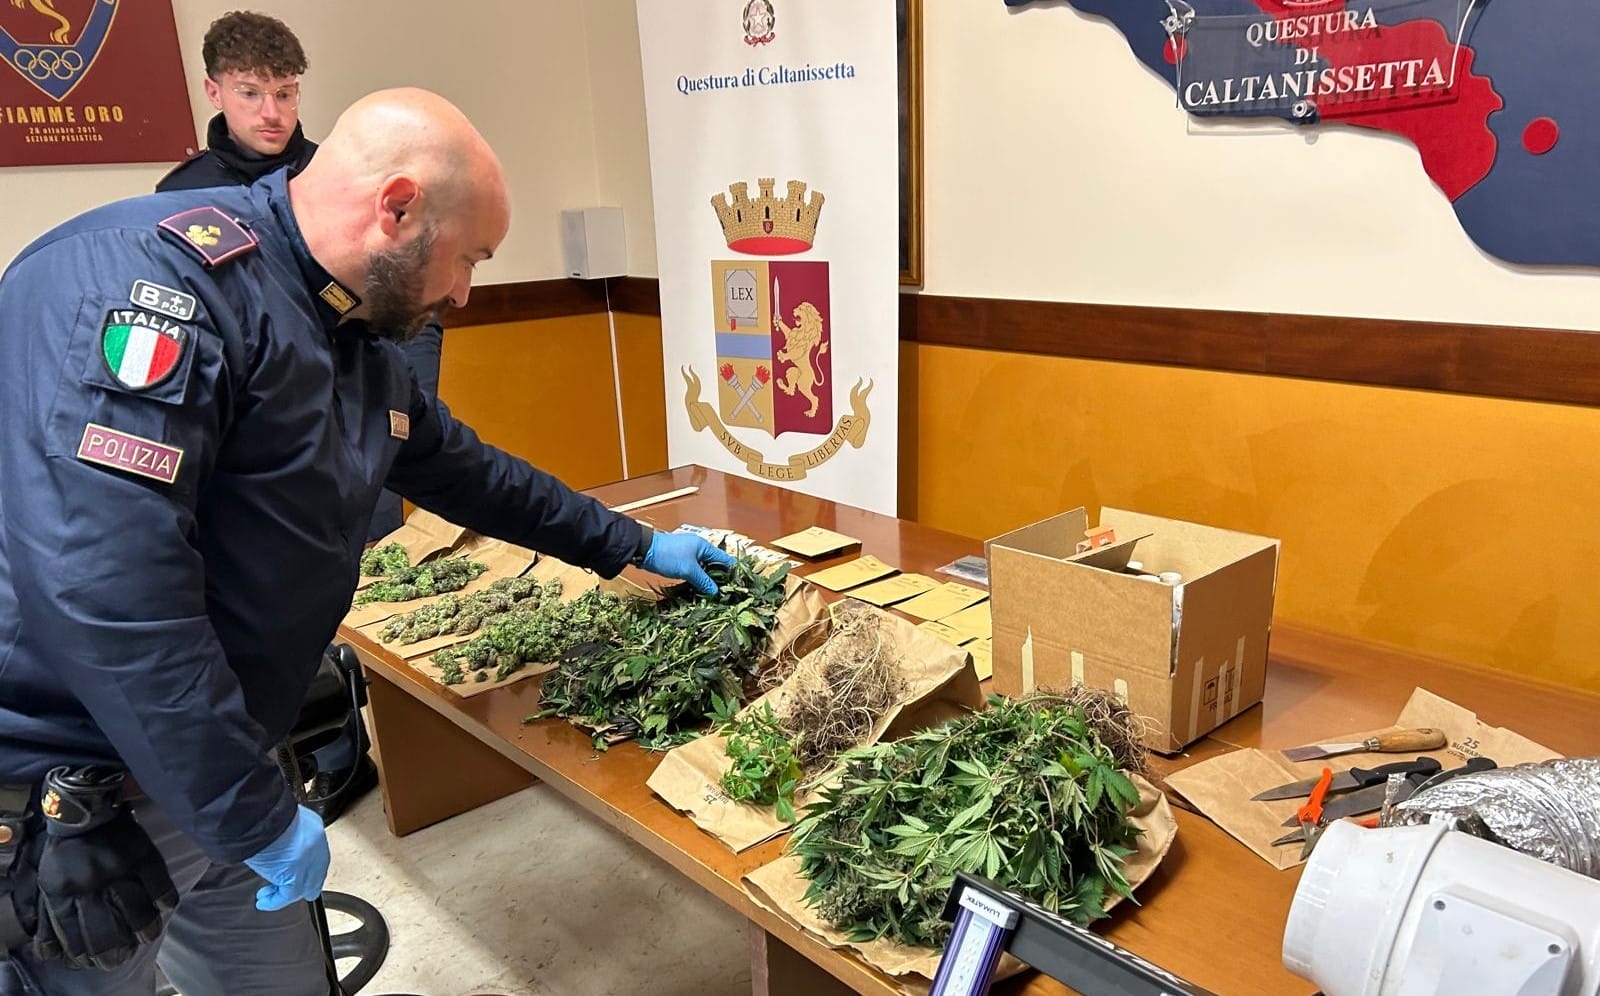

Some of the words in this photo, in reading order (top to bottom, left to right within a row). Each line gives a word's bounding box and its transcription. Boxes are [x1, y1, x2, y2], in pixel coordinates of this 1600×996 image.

[1246, 8, 1378, 47] QUESTURA
[1294, 46, 1319, 65] DI
[677, 74, 739, 95] Questura
[742, 68, 755, 87] di
[758, 62, 856, 86] Caltanissetta
[1184, 57, 1446, 107] CALTANISSETTA
[84, 105, 123, 123] ORO
[77, 126, 96, 134] 2011
[139, 285, 160, 306] B
[731, 287, 754, 301] LEX
[161, 301, 187, 316] POS
[113, 310, 180, 339] ITALIA
[87, 433, 170, 474] POLIZIA
[720, 431, 741, 455] SVB
[758, 464, 794, 479] LEGE
[806, 417, 852, 466] LIBERTAS
[1463, 737, 1480, 749] 25
[965, 895, 1000, 918] LUMATEK
